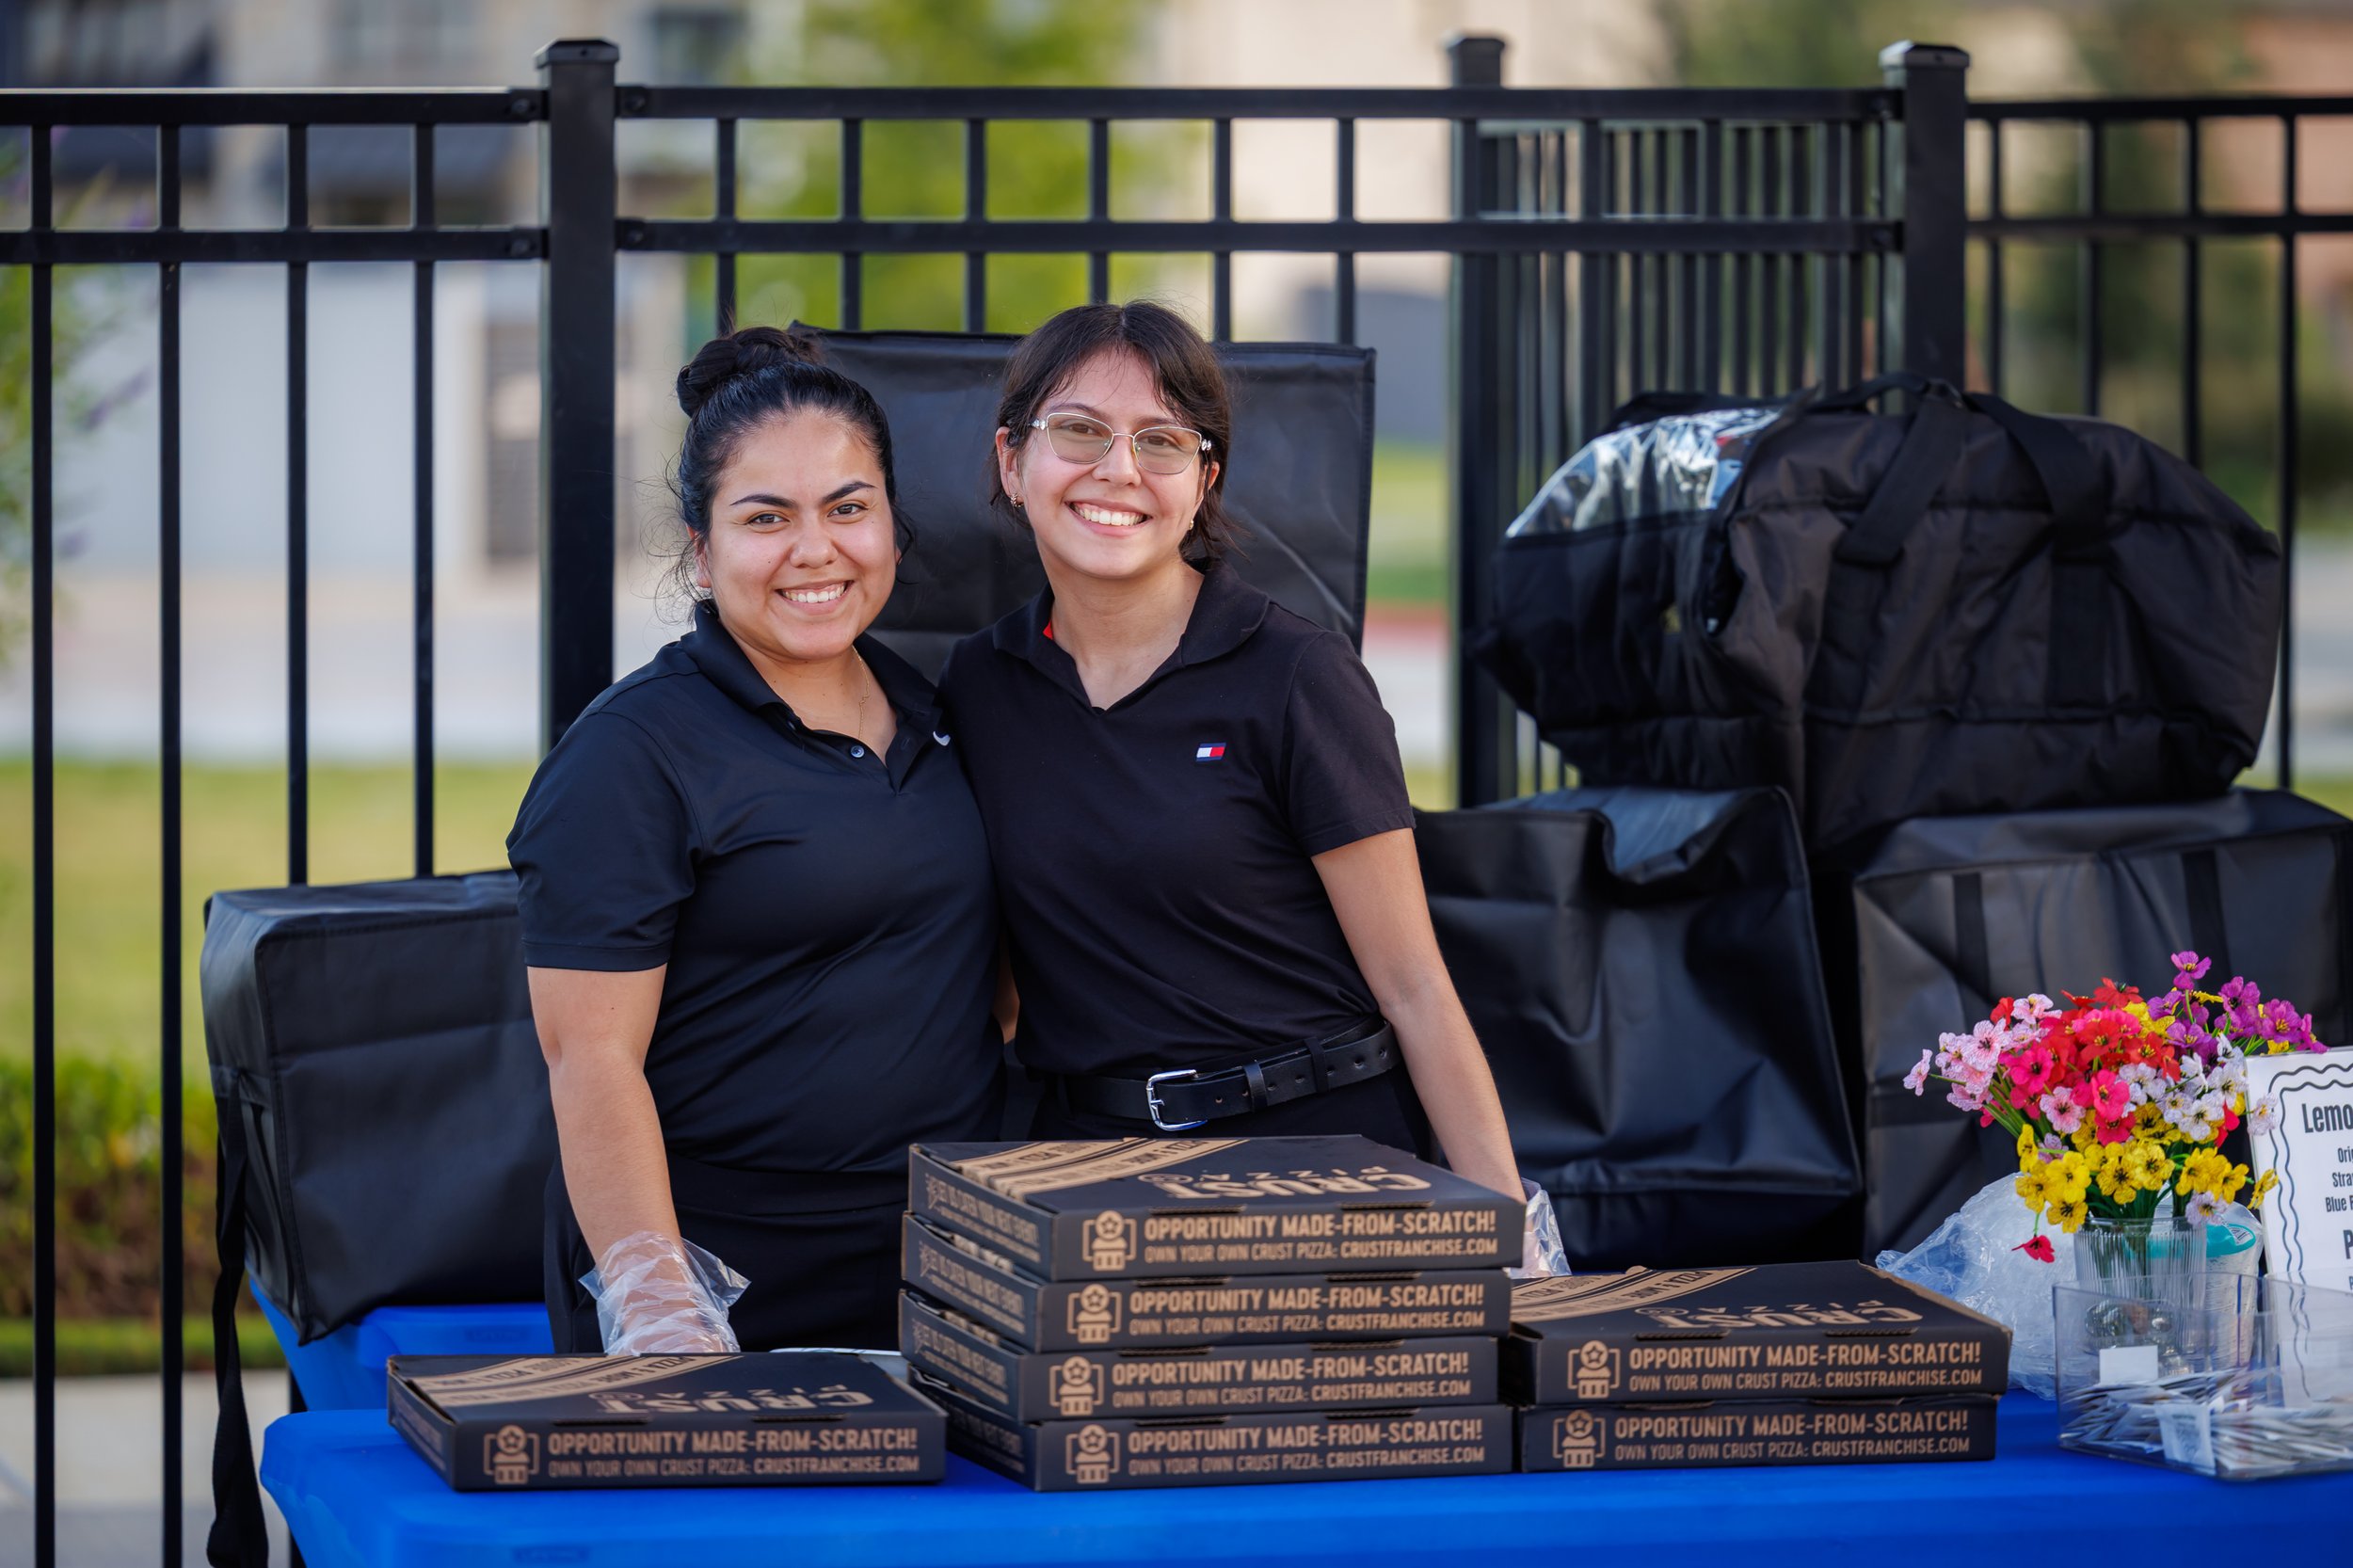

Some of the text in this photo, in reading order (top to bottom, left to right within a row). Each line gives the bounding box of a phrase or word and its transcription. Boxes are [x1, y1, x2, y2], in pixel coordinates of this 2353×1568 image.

[2301, 1103, 2353, 1133] Lemo
[1152, 1173, 1433, 1199] CRUST
[2331, 1172, 2353, 1188] Stra
[2325, 1196, 2347, 1212] Blue
[1144, 1209, 1497, 1241] OPPORTUNITY MADE-FROM-SCRATCH!
[1144, 1245, 1177, 1264] OWN
[1180, 1244, 1213, 1262] YOUR
[1217, 1243, 1249, 1262] OWN
[1251, 1242, 1294, 1261] CRUST
[1339, 1238, 1498, 1258] CRUSTFRANCHISE.COM
[1129, 1288, 1264, 1314] OPPORTUNITY
[1267, 1284, 1484, 1310] MADE-FROM-SCRATCH!
[1128, 1319, 1162, 1336] OWN
[1164, 1317, 1200, 1335] YOUR
[1201, 1317, 1235, 1335] OWN
[1236, 1315, 1279, 1334] CRUST
[1325, 1310, 1485, 1331] CRUSTFRANCHISE.COM
[1649, 1306, 1924, 1329] CRUST
[1628, 1341, 1981, 1370] OPPORTUNITY MADE-FROM-SCRATCH!
[1112, 1353, 1470, 1386] OPPORTUNITY MADE-FROM-SCRATCH!
[1629, 1375, 1662, 1392] OWN
[1664, 1373, 1699, 1391] YOUR
[1701, 1373, 1733, 1390] OWN
[1735, 1371, 1778, 1390] CRUST
[1824, 1368, 1982, 1388] CRUSTFRANCHISE.COM
[598, 1391, 874, 1414] CRUST
[1112, 1391, 1145, 1408] OWN
[1147, 1388, 1184, 1407] YOUR
[1185, 1388, 1219, 1406] OWN
[1220, 1386, 1264, 1405] CRUST
[1310, 1380, 1471, 1402] CRUSTFRANCHISE.COM
[1128, 1421, 1484, 1454] OPPORTUNITY MADE-FROM-SCRATCH!
[1614, 1410, 1968, 1439] OPPORTUNITY MADE-FROM-SCRATCH!
[548, 1428, 918, 1455] OPPORTUNITY MADE-FROM-SCRATCH!
[1614, 1444, 1647, 1462] OWN
[1650, 1443, 1685, 1461] YOUR
[1687, 1443, 1720, 1460] OWN
[1721, 1441, 1765, 1460] CRUST
[1811, 1436, 1970, 1457] CRUSTFRANCHISE.COM
[548, 1460, 580, 1478] OWN
[584, 1459, 619, 1478] YOUR
[623, 1459, 657, 1477] OWN
[661, 1458, 705, 1477] CRUST
[753, 1455, 920, 1475] CRUSTFRANCHISE.COM
[1128, 1458, 1161, 1477] OWN
[1163, 1457, 1198, 1475] YOUR
[1201, 1456, 1234, 1474] OWN
[1236, 1454, 1280, 1473] CRUST
[1325, 1448, 1485, 1469] CRUSTFRANCHISE.COM
